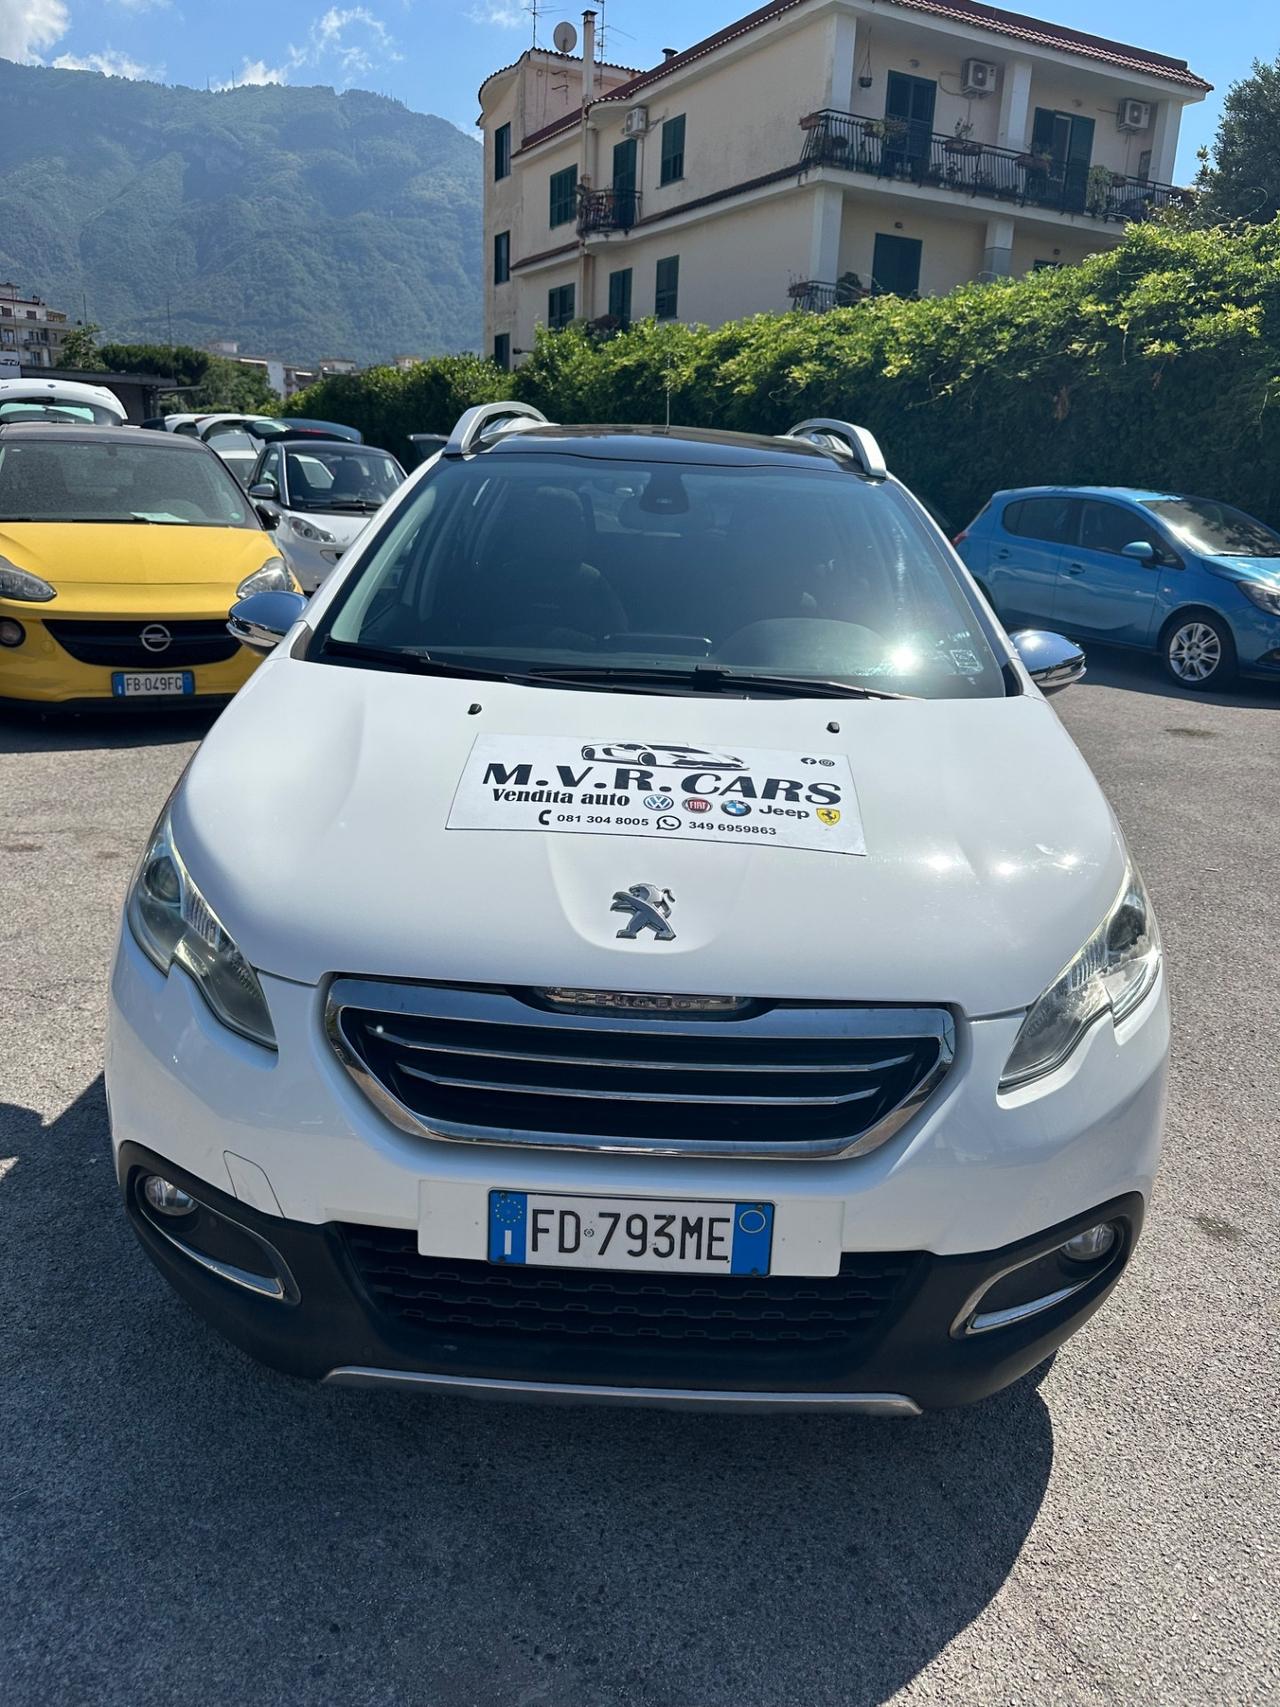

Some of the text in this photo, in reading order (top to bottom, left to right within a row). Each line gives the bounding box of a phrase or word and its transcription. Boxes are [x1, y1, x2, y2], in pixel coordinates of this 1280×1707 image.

[482, 763, 841, 806] M.V.R. CARS
[493, 788, 630, 807] Vendita auto
[689, 801, 706, 810] FIAT
[759, 805, 810, 819] Jeep
[557, 814, 649, 826] 081 304 8005
[689, 821, 777, 835] 349 6959863
